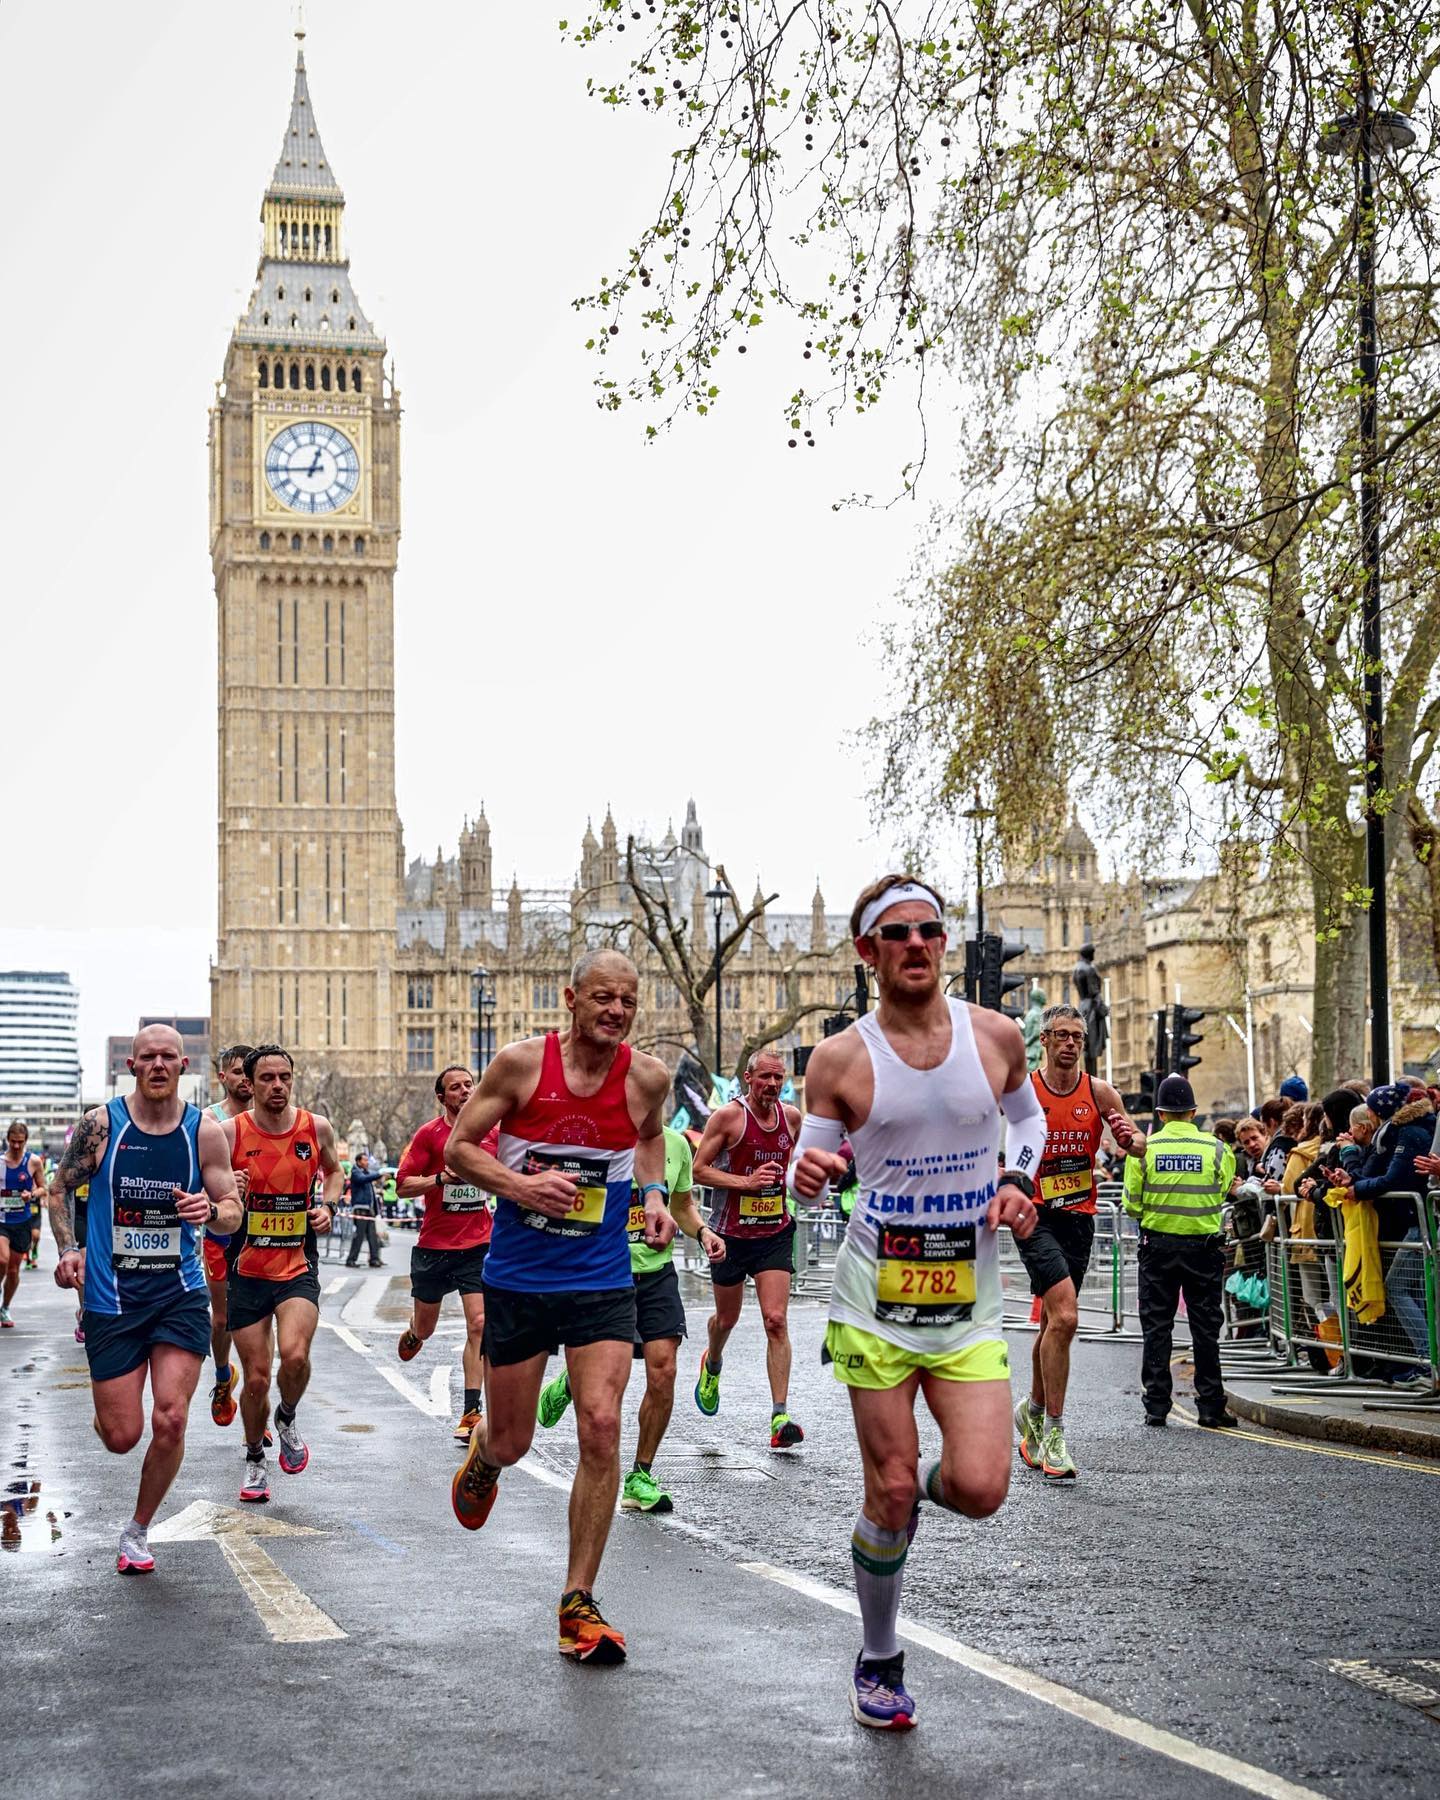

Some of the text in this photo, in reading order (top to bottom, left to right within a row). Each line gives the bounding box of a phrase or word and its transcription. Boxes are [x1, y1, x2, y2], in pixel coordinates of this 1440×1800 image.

[1047, 1131, 1090, 1140] ESTERN
[754, 1150, 783, 1161] Ripon
[563, 1161, 581, 1169] TATA
[1157, 1160, 1201, 1171] POLICE
[120, 1176, 181, 1190] Ballymena
[751, 1201, 776, 1212] 5662
[868, 1190, 914, 1213] LDN
[117, 1207, 142, 1225] tcs
[261, 1217, 295, 1232] 4113
[545, 1226, 561, 1235] new
[124, 1232, 170, 1249] 30698
[924, 1233, 946, 1241] TATA
[884, 1231, 920, 1256] tcs
[924, 1240, 970, 1249] CONSULTANCY
[924, 1249, 956, 1257] SERVICES
[900, 1268, 957, 1294] 2782
[916, 1316, 935, 1324] new
